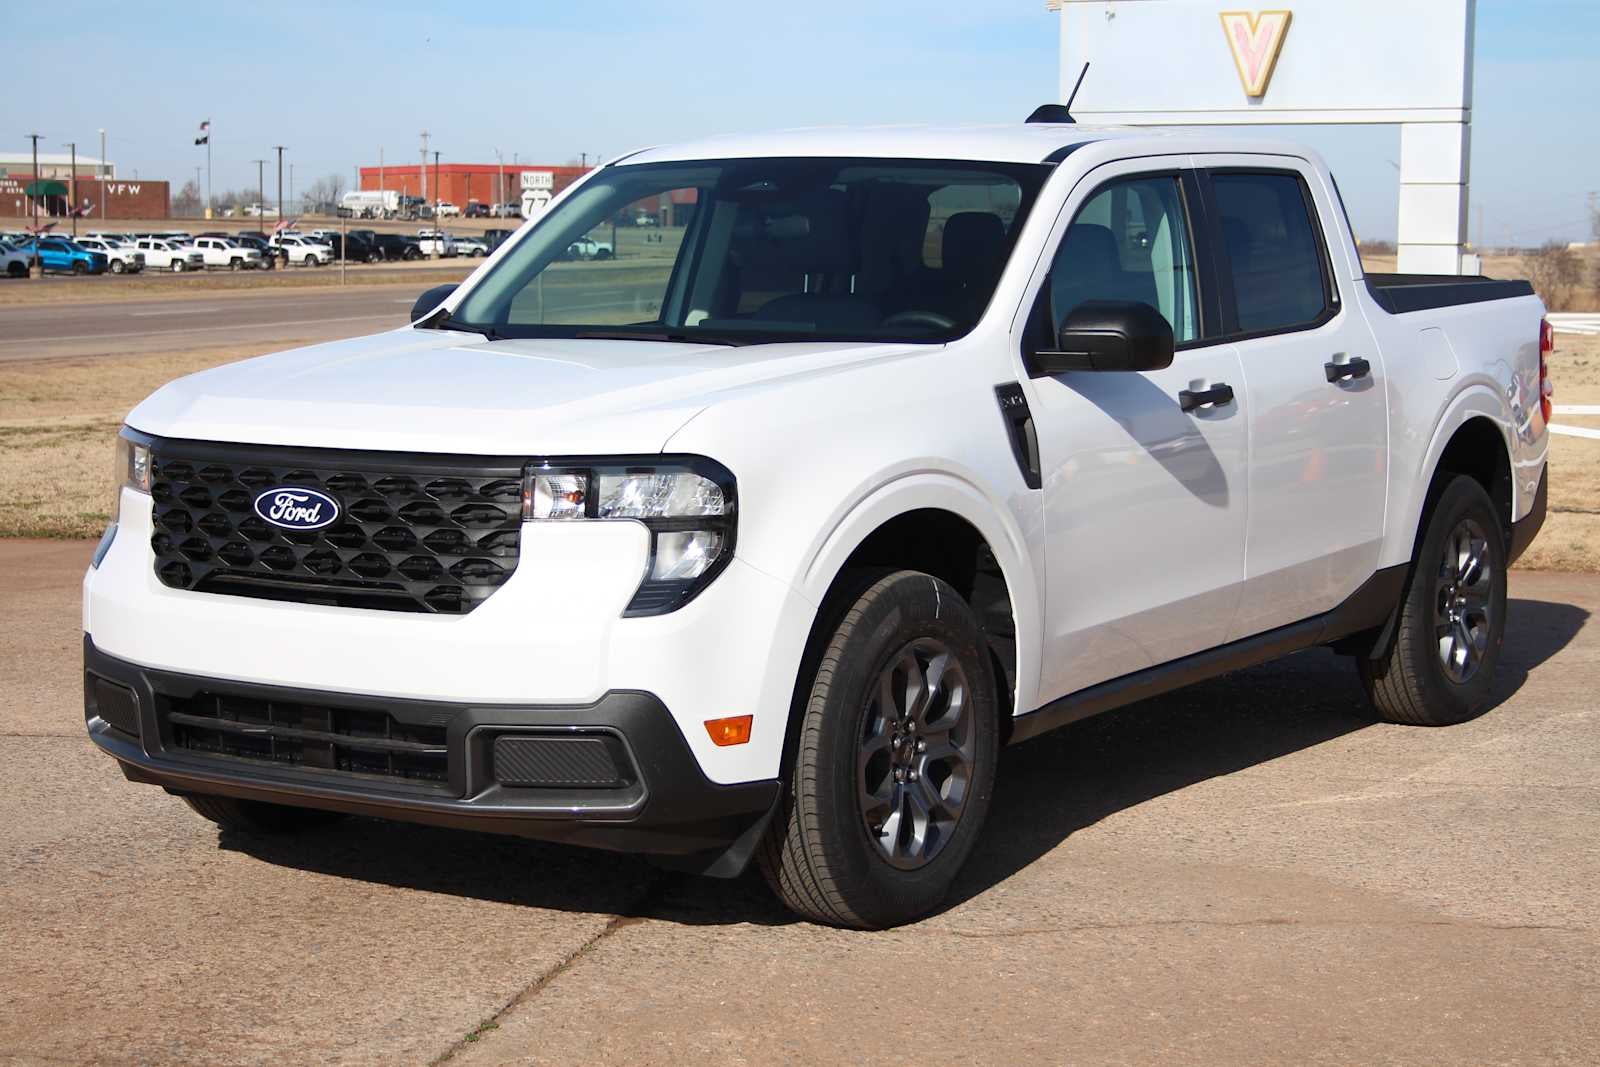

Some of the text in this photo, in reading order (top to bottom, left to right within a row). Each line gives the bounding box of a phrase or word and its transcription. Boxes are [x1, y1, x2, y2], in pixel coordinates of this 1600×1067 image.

[1218, 10, 1292, 97] V
[523, 175, 551, 185] NORTH
[107, 184, 141, 195] VFW
[524, 197, 548, 215] 77
[269, 492, 322, 523] Ford
